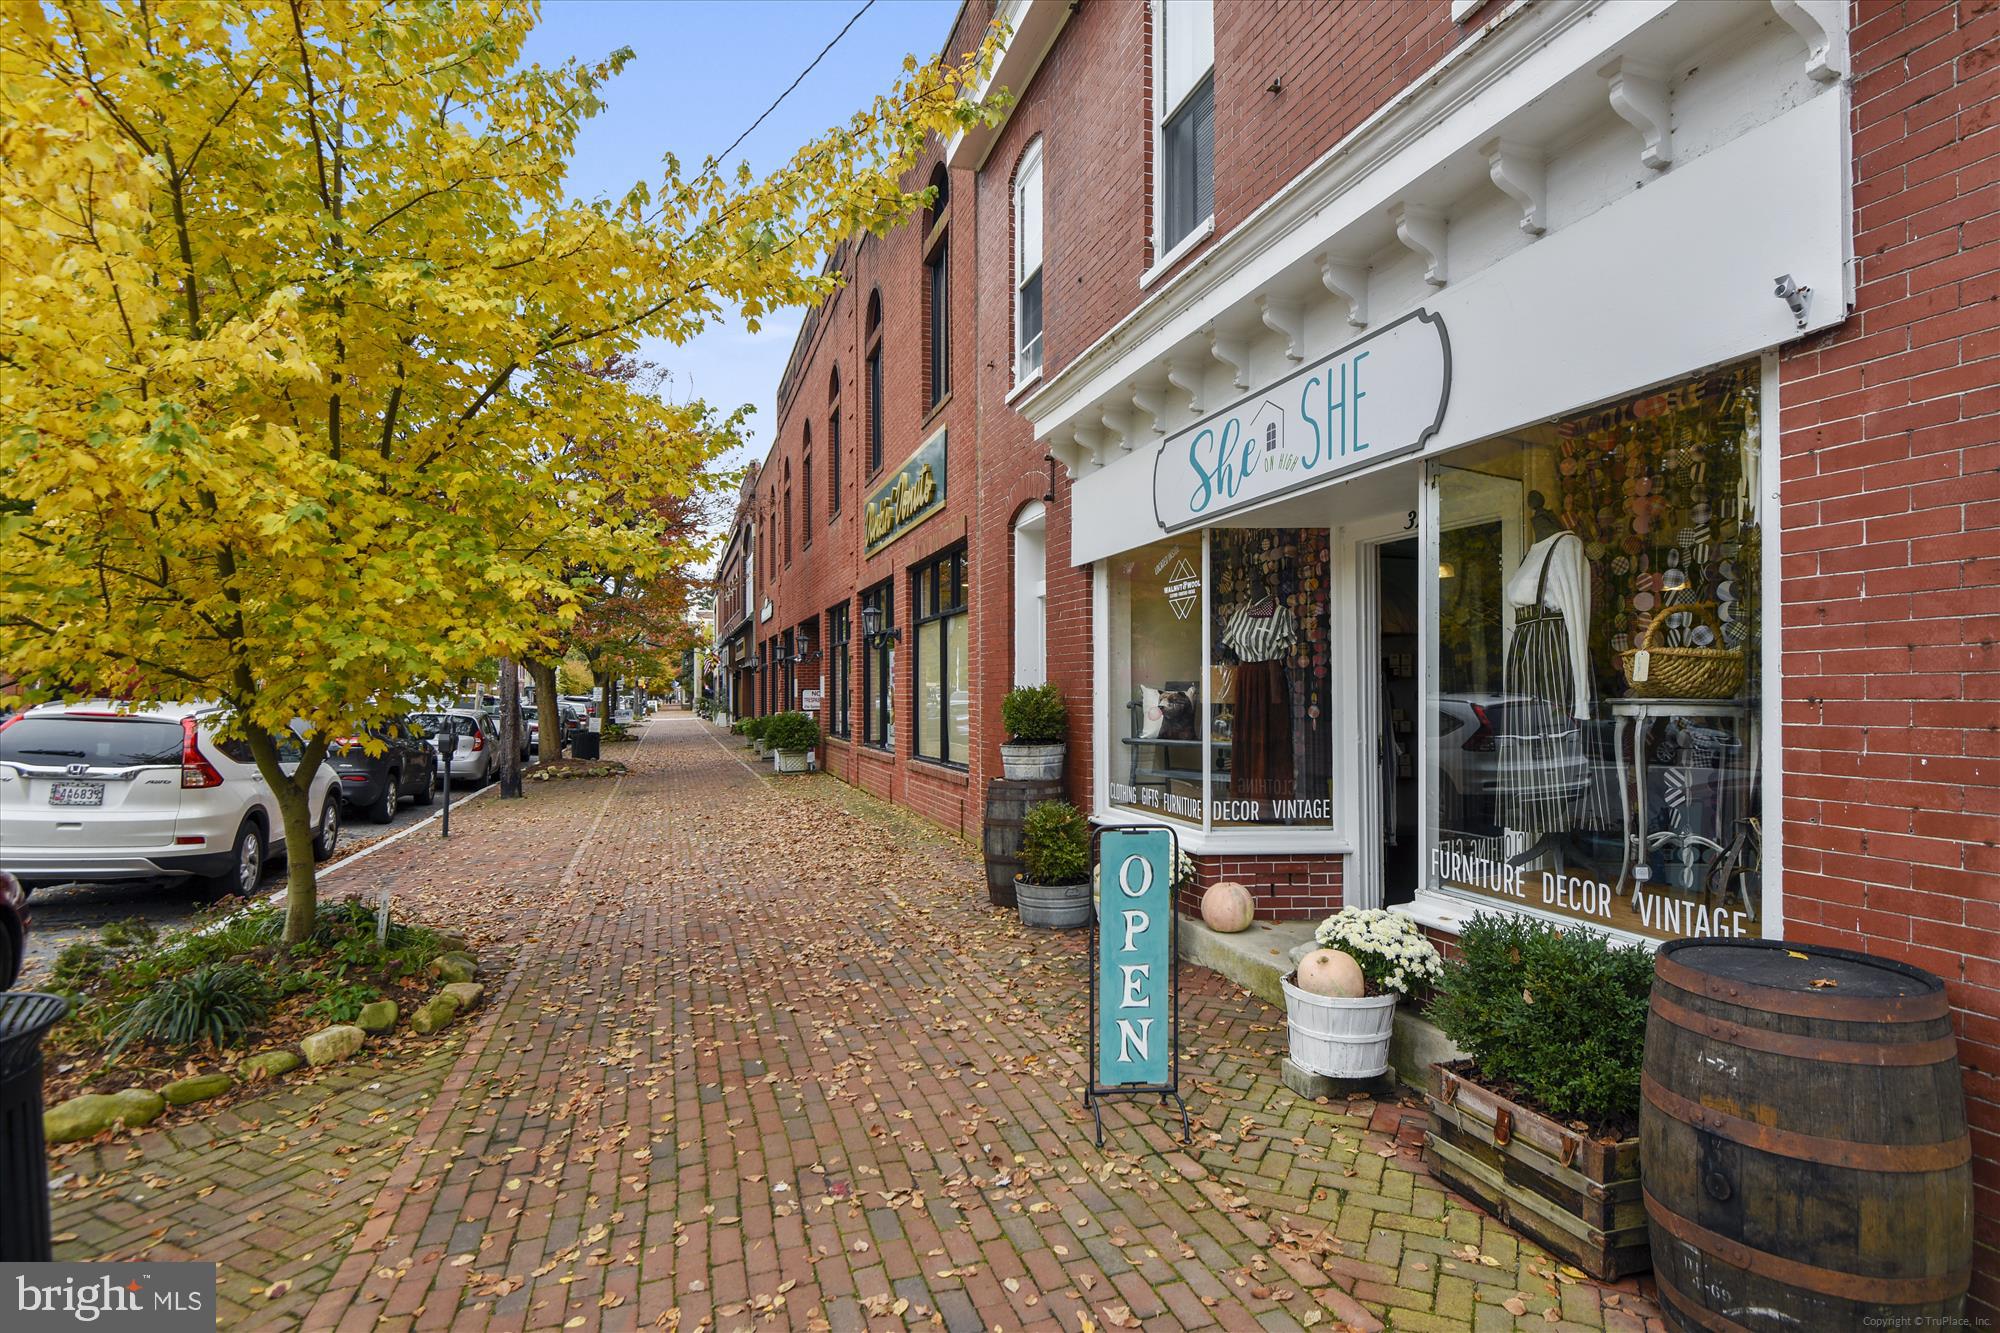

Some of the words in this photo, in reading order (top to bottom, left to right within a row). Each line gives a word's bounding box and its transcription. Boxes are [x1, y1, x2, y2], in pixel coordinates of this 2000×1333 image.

[1189, 418, 1262, 512] She
[1301, 351, 1370, 470] SHE
[1109, 782, 1137, 804] CLOTHING
[1141, 786, 1159, 809] GIFTS
[1163, 792, 1202, 820] FURNITURE
[1212, 800, 1260, 821] DECOR
[1272, 799, 1331, 819] VINTAGE
[1431, 848, 1526, 898] FURNITURE
[1541, 871, 1612, 919] DECOR
[1638, 891, 1747, 938] VINTAGE
[1115, 854, 1155, 1064] OPEN
